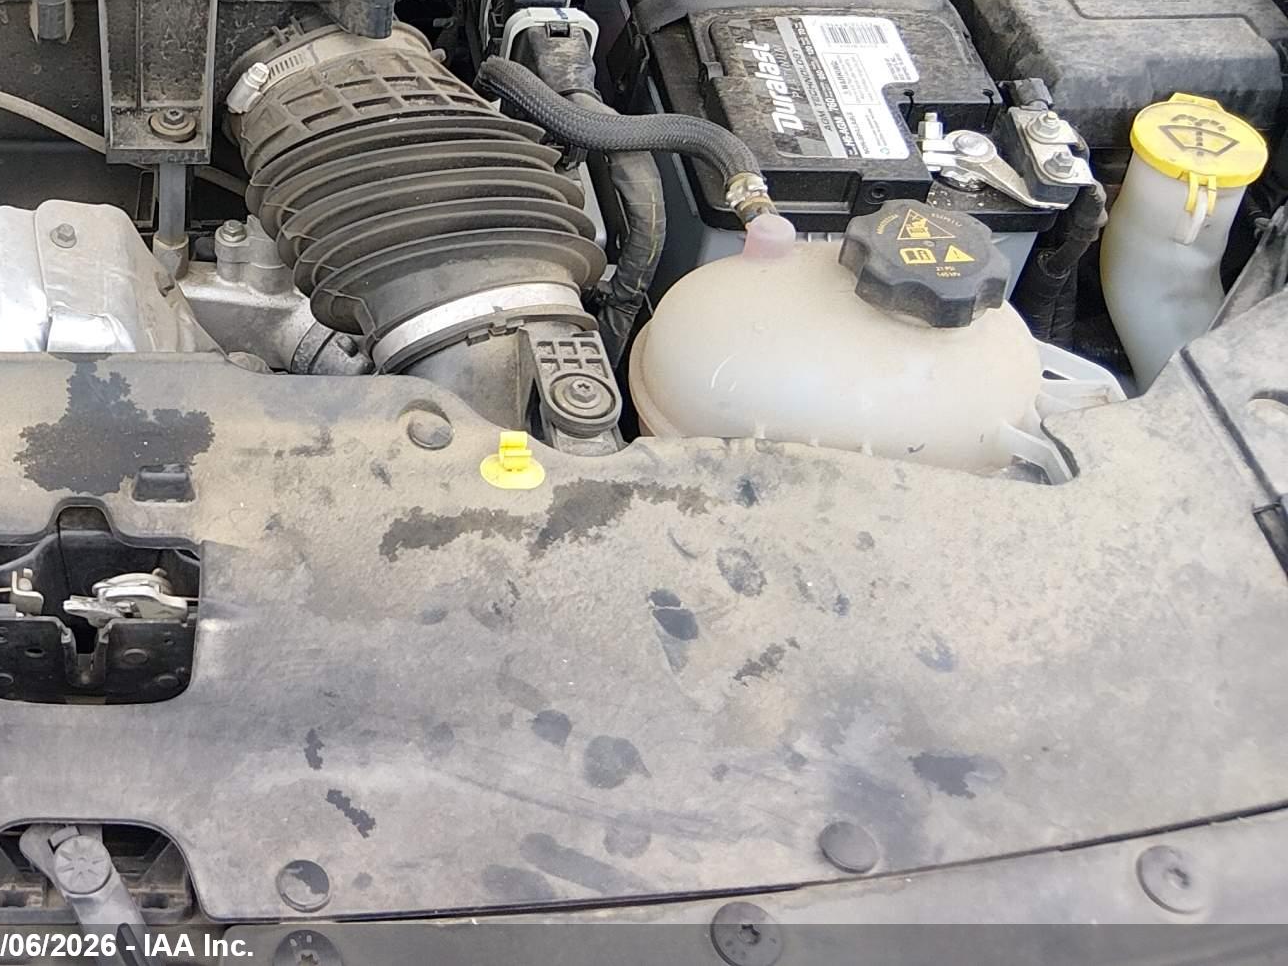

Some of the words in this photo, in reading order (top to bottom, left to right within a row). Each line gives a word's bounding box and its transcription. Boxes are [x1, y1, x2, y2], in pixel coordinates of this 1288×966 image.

[743, 39, 804, 134] Duralast
[790, 46, 822, 107] TECHNOLOGY
[817, 110, 833, 132] AGM
[825, 97, 839, 113] 760
